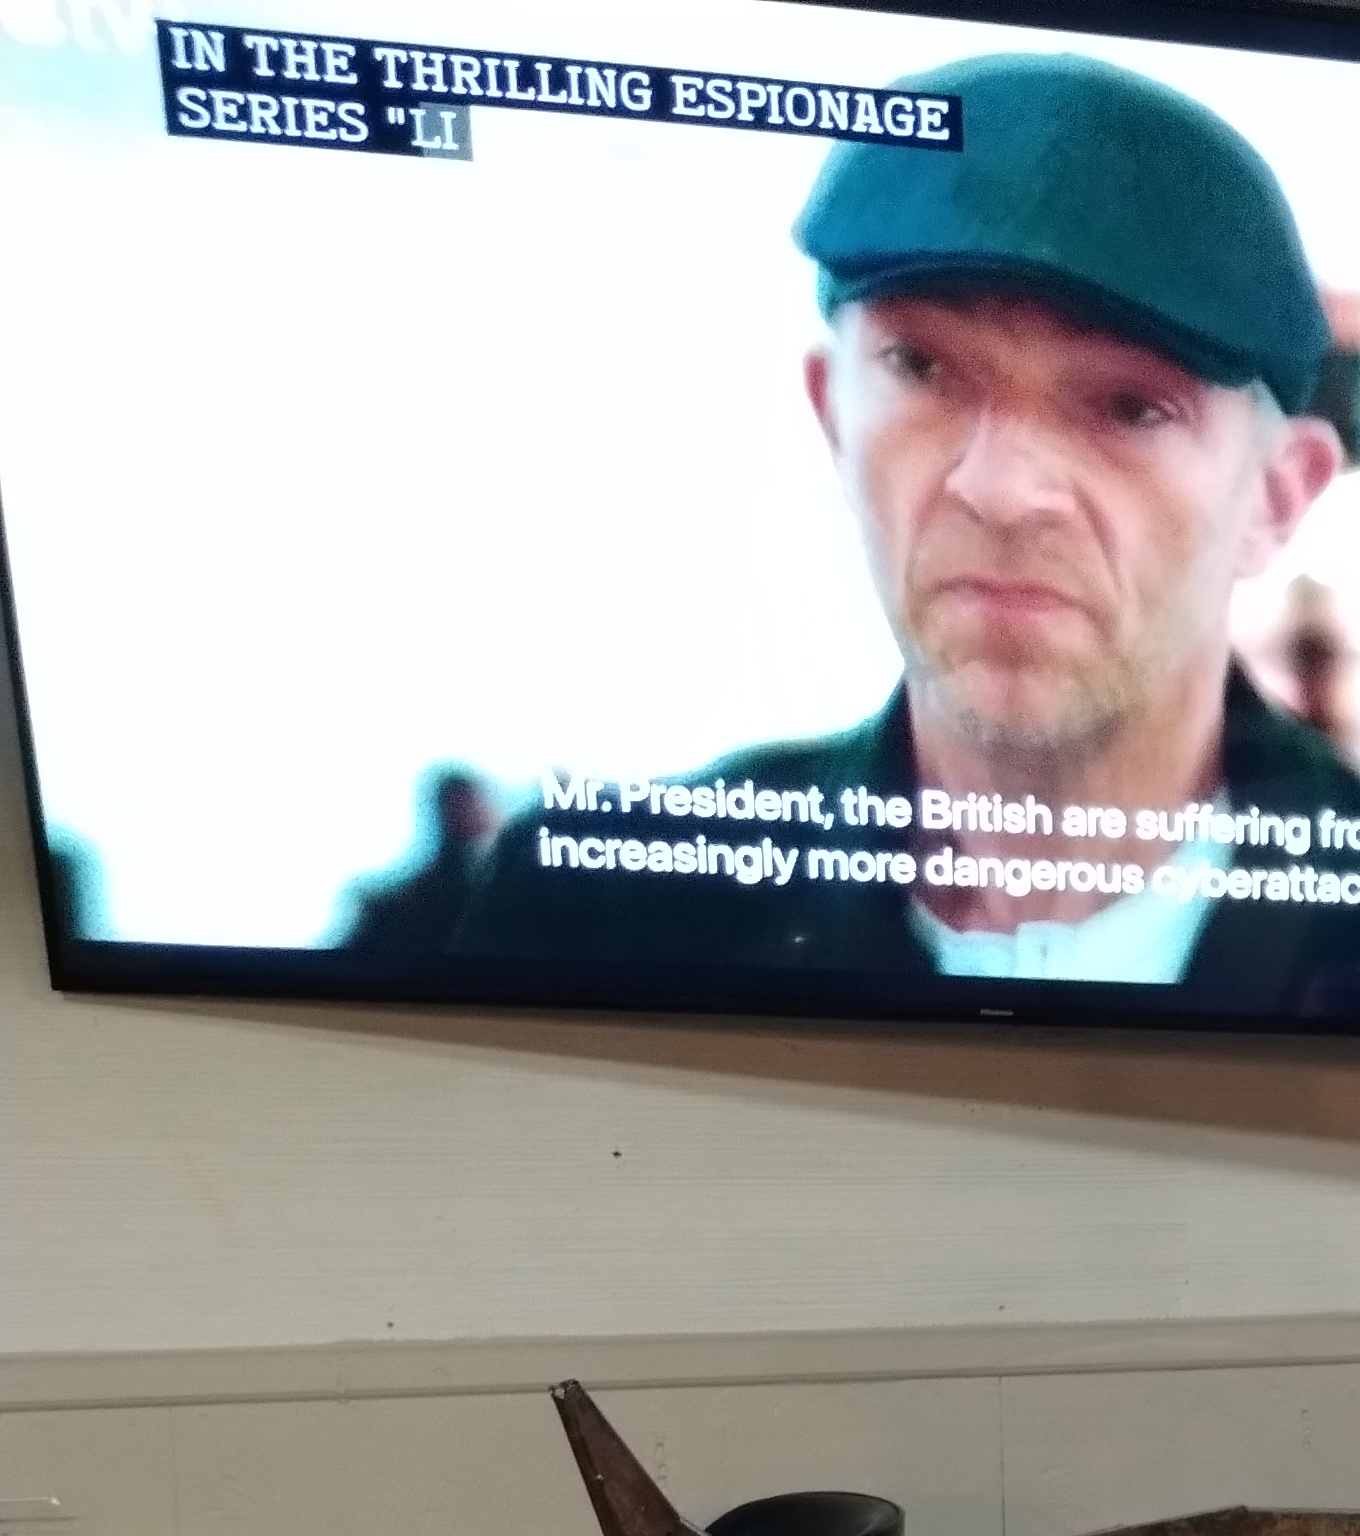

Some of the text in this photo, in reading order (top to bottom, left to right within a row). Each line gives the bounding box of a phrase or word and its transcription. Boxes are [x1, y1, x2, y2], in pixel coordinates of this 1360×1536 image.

[169, 27, 950, 140] IN THE THRILLING ESPIONAGE
[177, 87, 369, 143] SERIES
[542, 771, 611, 813] Mr.
[620, 775, 834, 831] President,
[841, 786, 912, 828] the
[922, 789, 1052, 836] British
[1062, 804, 1127, 839] are
[1136, 803, 1311, 855] suffering
[539, 827, 799, 886] increasingly
[808, 846, 916, 884] more
[926, 847, 1144, 897] dangerous
